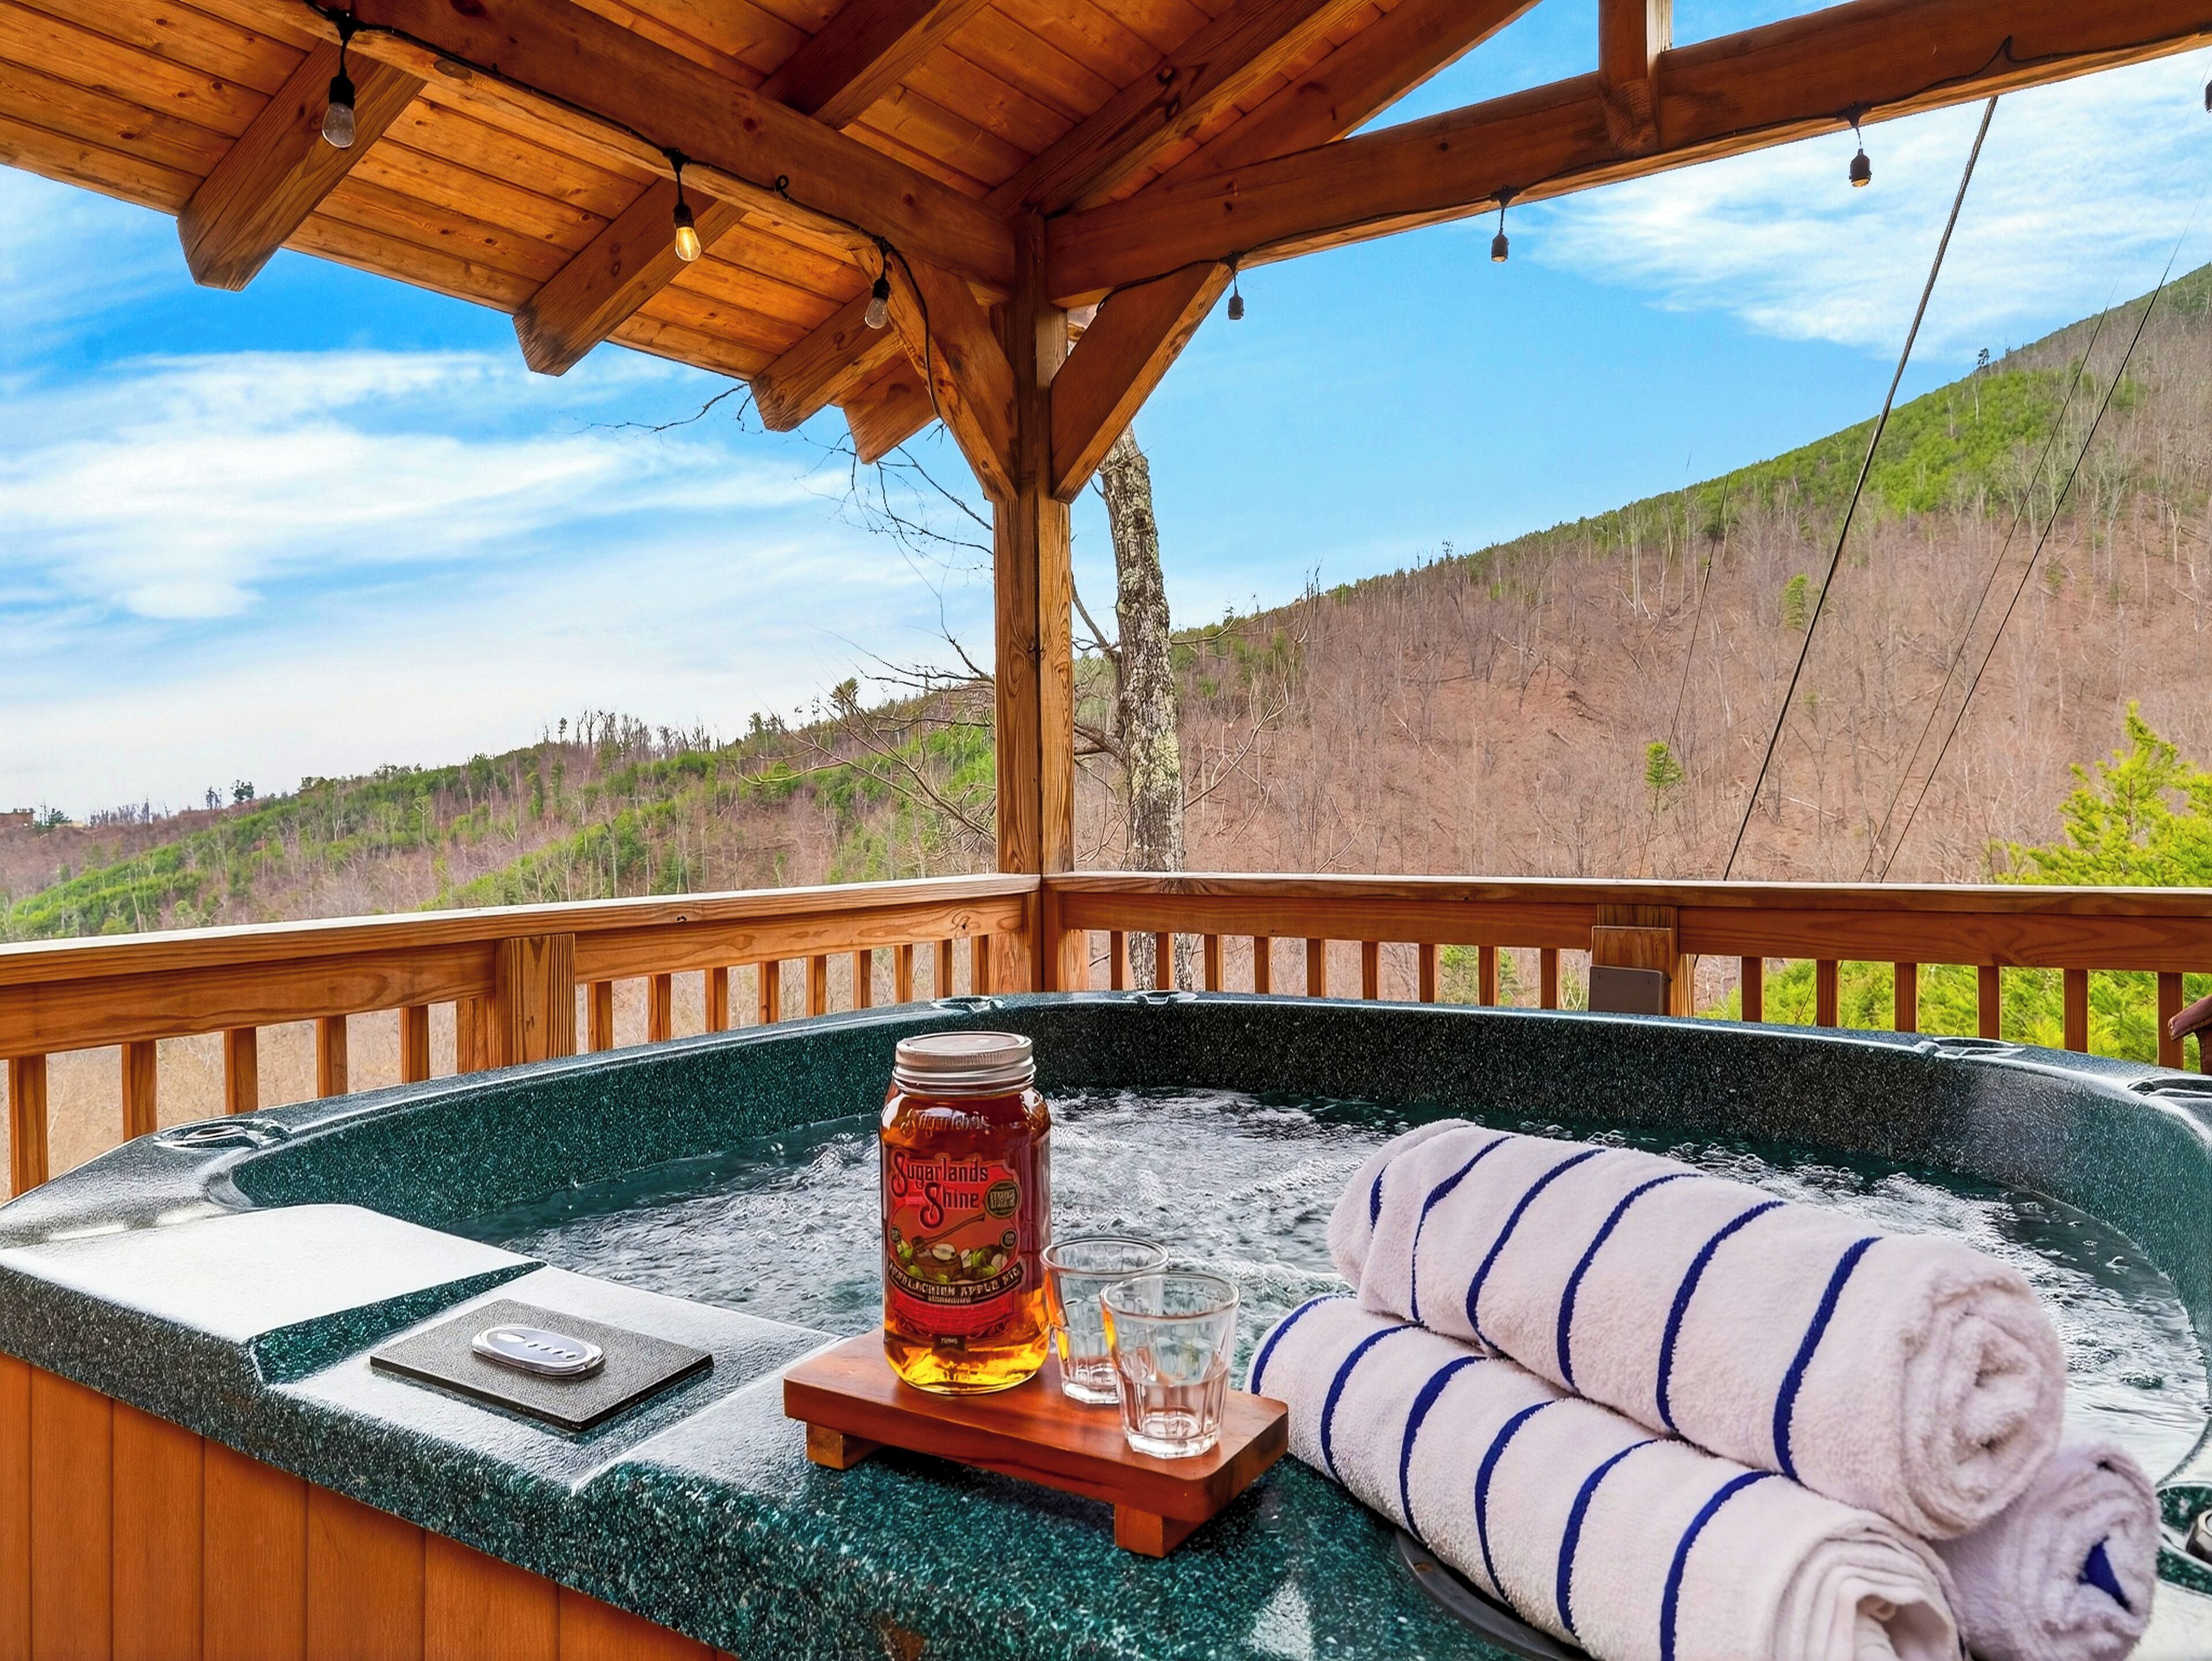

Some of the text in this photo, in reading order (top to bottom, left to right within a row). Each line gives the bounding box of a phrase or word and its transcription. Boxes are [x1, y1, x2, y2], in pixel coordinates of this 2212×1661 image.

[891, 1151, 988, 1198] Sugarlands
[919, 1182, 979, 1229] Shine
[961, 1280, 999, 1296] APPLE
